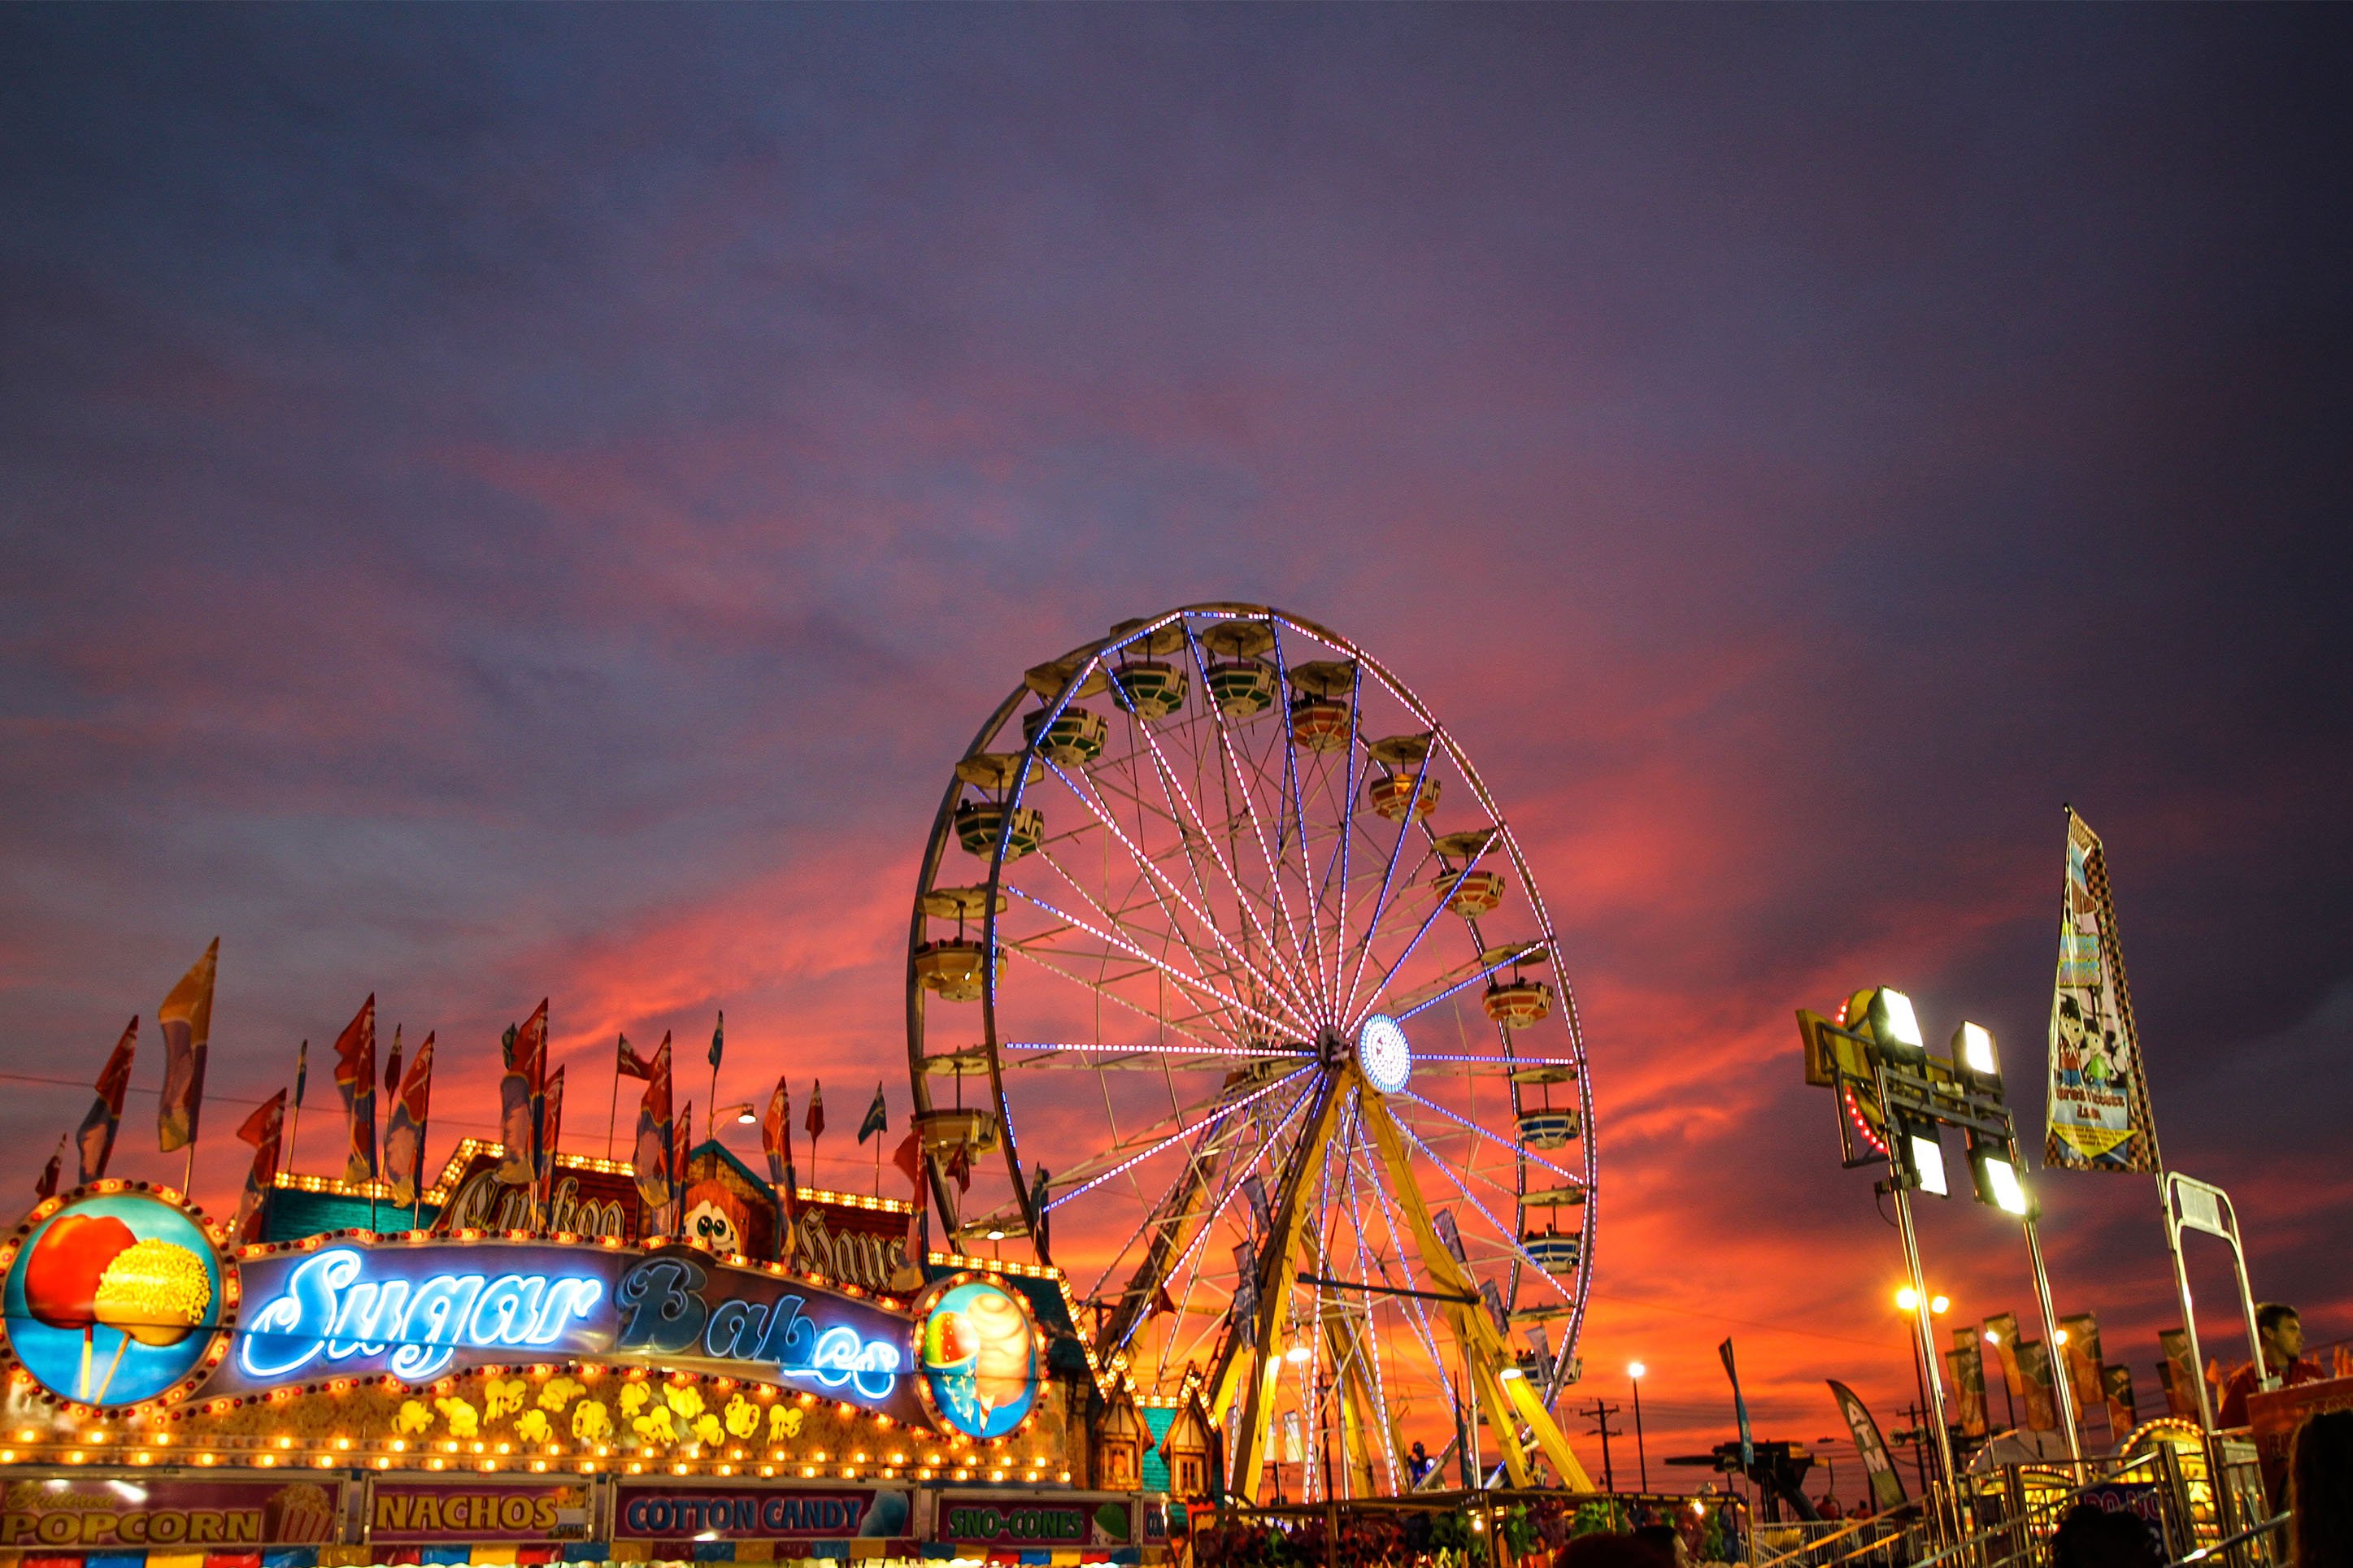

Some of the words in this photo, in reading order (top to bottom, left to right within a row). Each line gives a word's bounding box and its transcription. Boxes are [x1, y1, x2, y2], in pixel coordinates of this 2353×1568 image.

[242, 1249, 603, 1379] Sugar
[614, 1256, 900, 1399] Babes
[1846, 1401, 1890, 1474] ATM
[375, 1494, 559, 1531] NACHOS
[627, 1497, 758, 1531] COTTON
[763, 1497, 863, 1531] CANDY
[2125, 1490, 2162, 1522] NO
[1, 1510, 262, 1544] POPCORN
[948, 1509, 1084, 1539] SNO-CONES
[1146, 1510, 1164, 1537] COL
